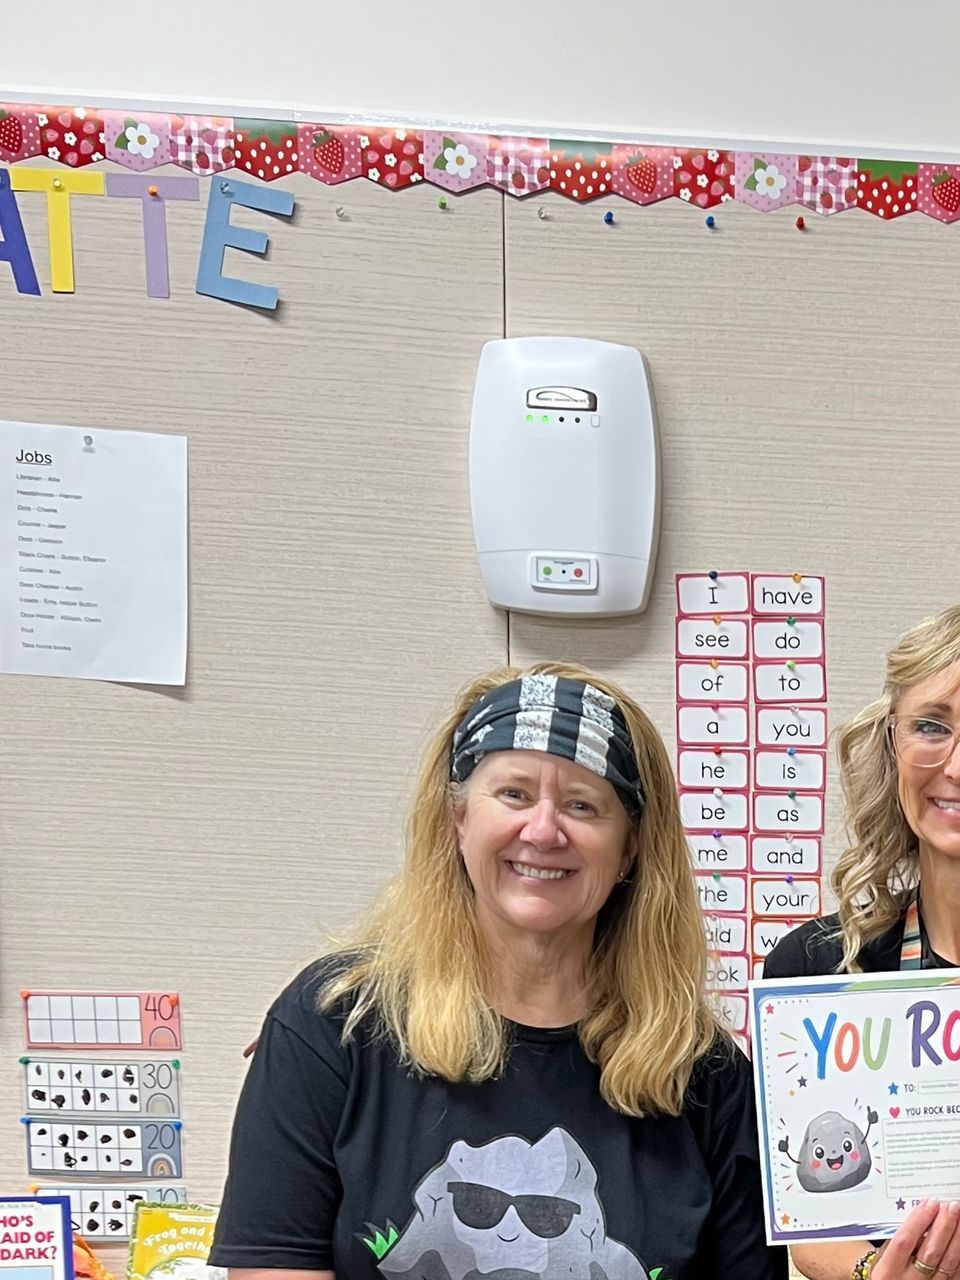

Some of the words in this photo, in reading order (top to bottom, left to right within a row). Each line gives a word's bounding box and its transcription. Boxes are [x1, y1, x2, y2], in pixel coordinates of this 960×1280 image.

[16, 449, 52, 465] Jobs
[708, 587, 718, 604] I
[762, 587, 813, 605] have
[695, 634, 729, 648] see
[775, 632, 801, 649] do
[701, 675, 724, 691] of
[778, 675, 801, 691] to
[706, 721, 719, 734] a
[773, 723, 811, 741] you
[701, 762, 725, 779] he
[782, 764, 796, 779] is
[701, 804, 726, 820] be
[777, 809, 799, 822] as
[698, 849, 728, 862] me
[766, 848, 803, 864] and
[698, 886, 728, 902] the
[762, 894, 810, 912] your
[145, 995, 174, 1020] 40
[803, 1012, 892, 1080] YOU
[143, 1064, 173, 1089] 30
[904, 1083, 917, 1093] TO:
[905, 1107, 921, 1116] YOU
[924, 1105, 944, 1115] ROCK
[144, 1123, 175, 1150] 20
[35, 1231, 55, 1243] OF
[181, 1226, 206, 1237] and
[0, 1246, 57, 1260] DARK?
